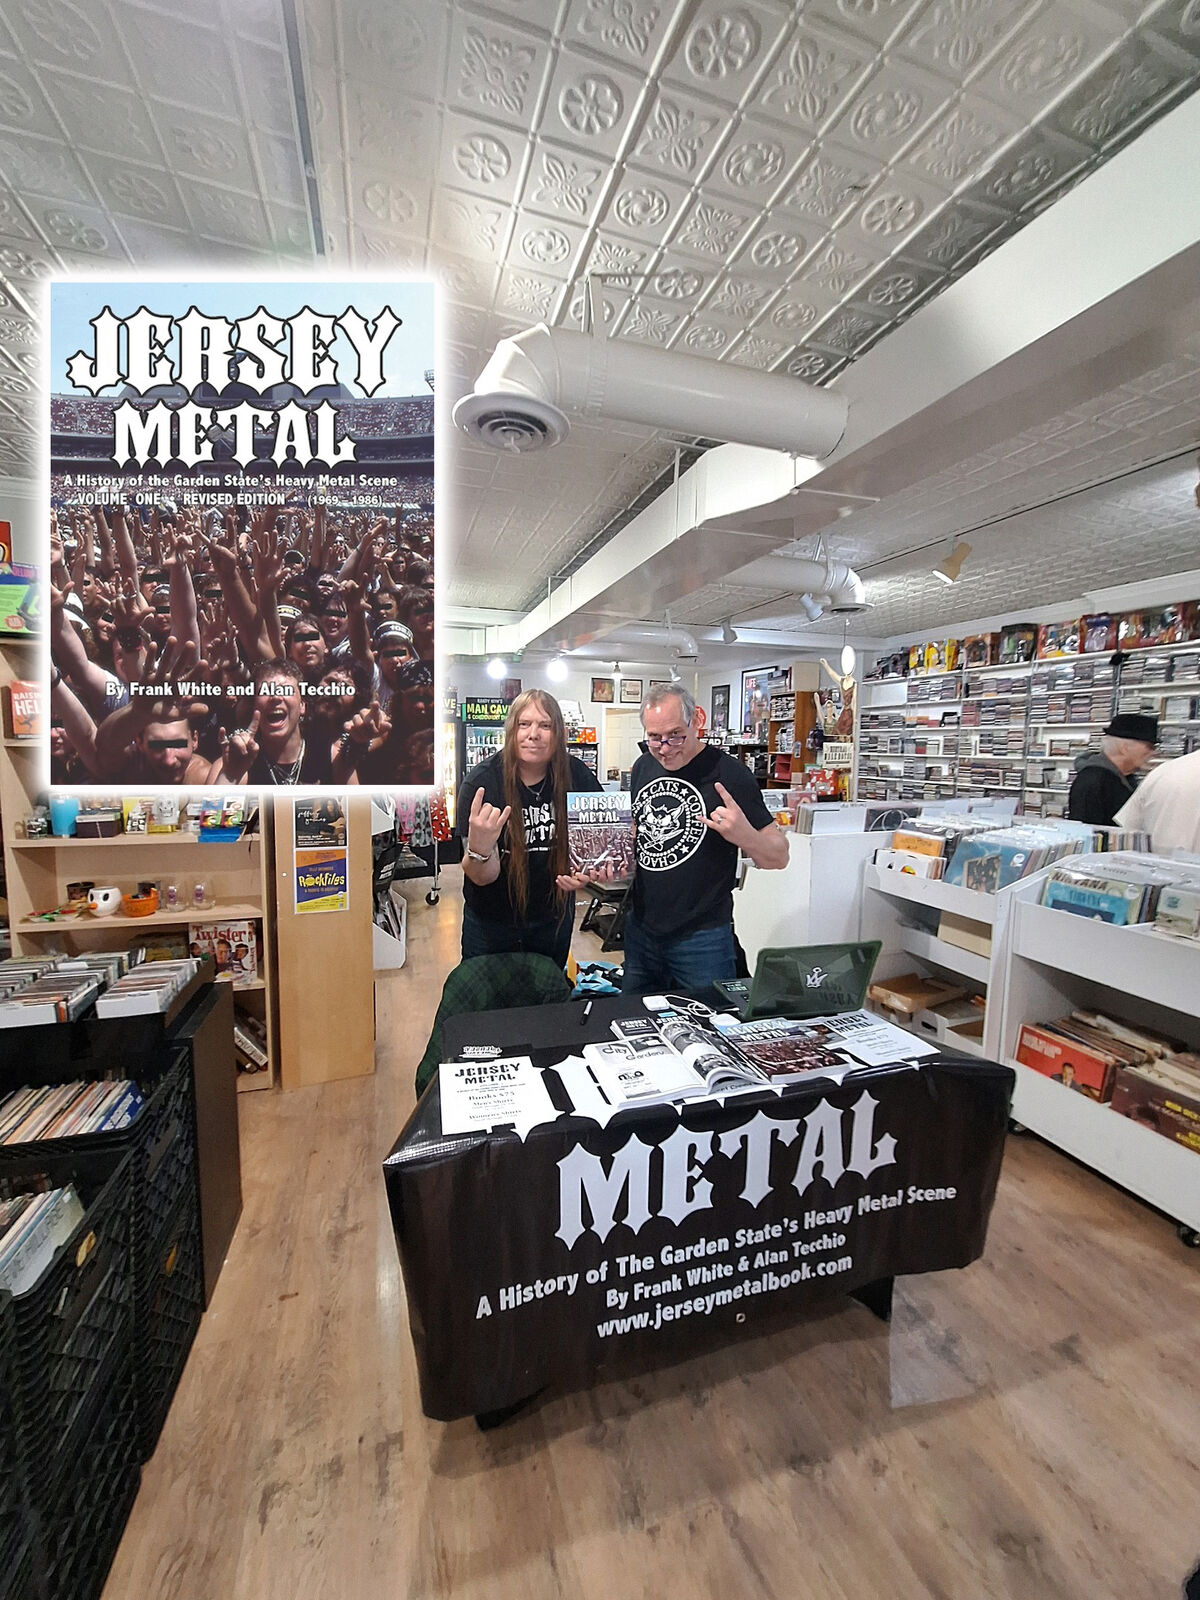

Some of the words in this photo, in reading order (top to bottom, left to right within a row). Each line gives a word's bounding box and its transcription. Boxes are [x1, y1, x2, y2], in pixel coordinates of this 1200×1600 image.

[15, 699, 42, 716] HEL
[467, 703, 488, 714] MAN
[490, 704, 509, 714] CAV
[649, 780, 680, 795] CATS
[571, 795, 627, 811] JERSEY
[578, 810, 620, 824] METAL
[640, 852, 678, 868] CHAOS
[1051, 871, 1109, 892] NIRVANA
[192, 925, 247, 943] Twister
[725, 1020, 787, 1036] JERSEY
[740, 1030, 791, 1043] METAL
[602, 1044, 627, 1055] City
[455, 1063, 521, 1078] JERSEY
[465, 1073, 516, 1085] METAL
[555, 1089, 898, 1250] METAL
[476, 1295, 493, 1320] A
[499, 1273, 579, 1312] History
[585, 1261, 608, 1285] of
[616, 1254, 655, 1278] The
[660, 1238, 730, 1266] Garden
[734, 1217, 799, 1249] State's
[803, 1204, 854, 1230] Heavy
[857, 1189, 904, 1216] Metal
[906, 1185, 957, 1204] Scene
[606, 1288, 629, 1310] By
[633, 1274, 682, 1302] Frank
[686, 1260, 734, 1288] White
[737, 1255, 750, 1273] &
[753, 1249, 789, 1270] Alan
[792, 1232, 846, 1259] Tecchio
[596, 1255, 853, 1338] www.jerseymetalbook.com
